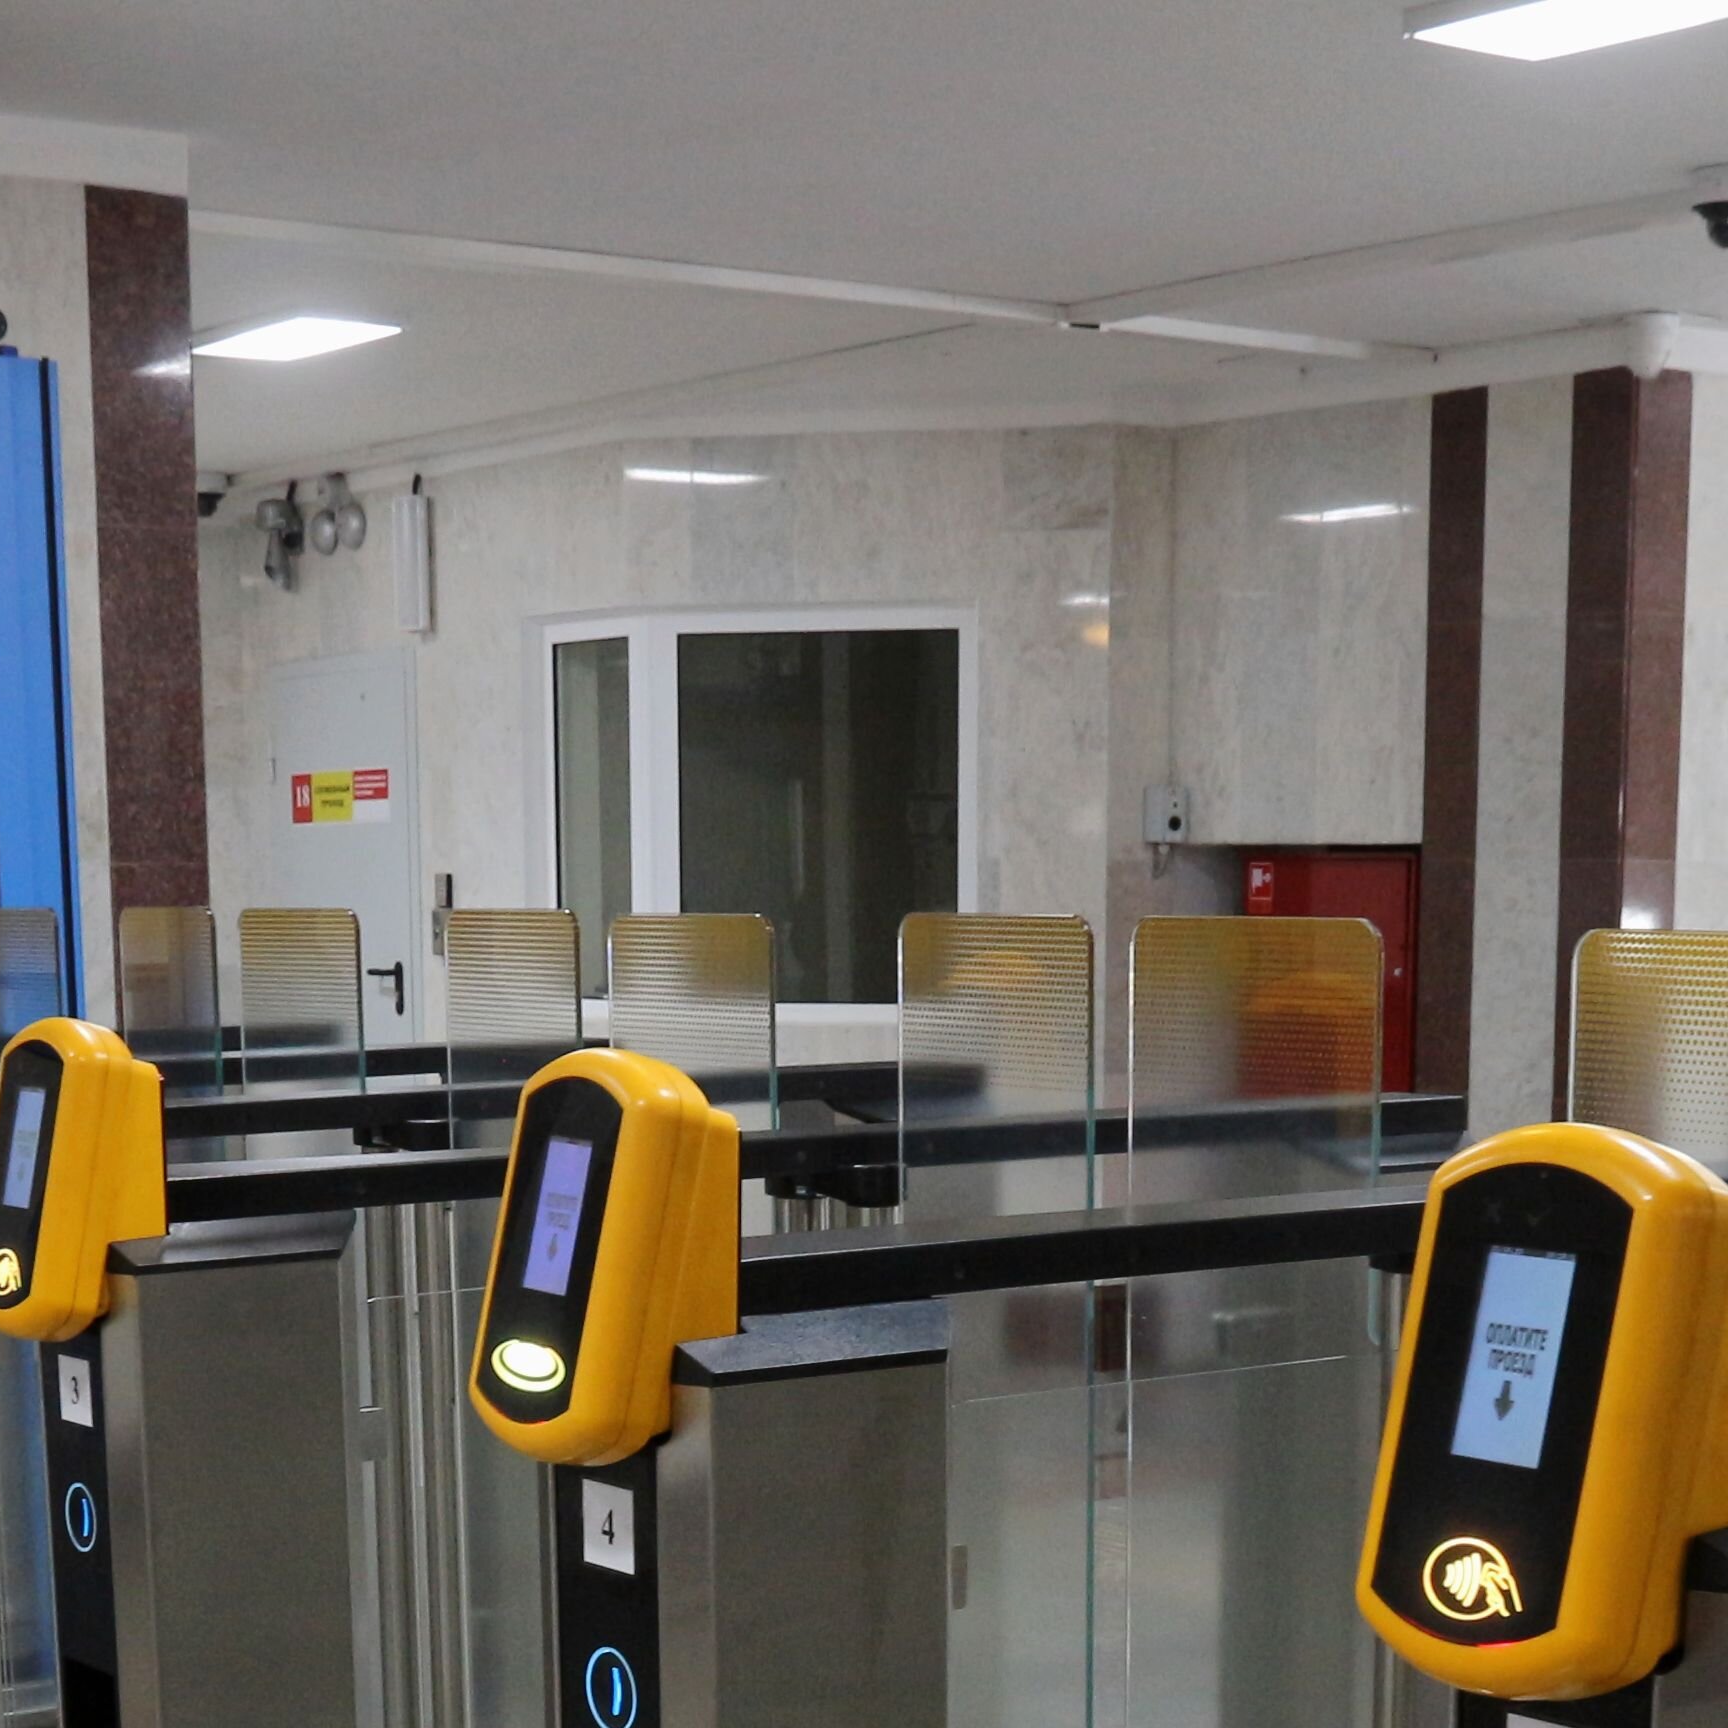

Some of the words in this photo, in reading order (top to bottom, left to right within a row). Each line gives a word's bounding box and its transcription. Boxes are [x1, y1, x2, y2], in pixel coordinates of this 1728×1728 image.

[296, 784, 310, 808] 18
[1486, 1322, 1549, 1351] ОПЛАТИТЕ
[1488, 1348, 1537, 1379] ПРОЕЗД
[71, 1375, 80, 1405] 3
[601, 1509, 615, 1546] 4
